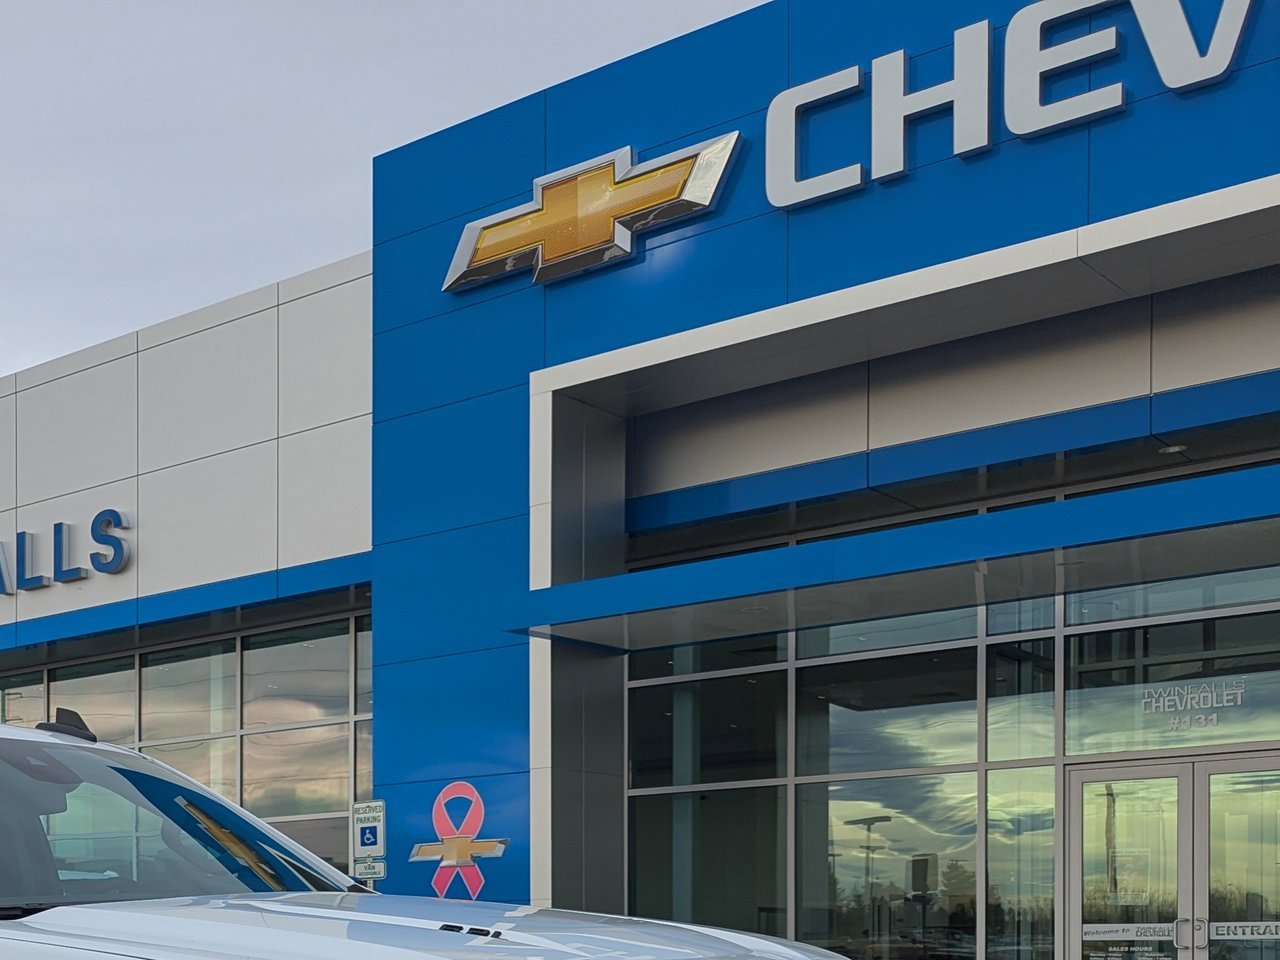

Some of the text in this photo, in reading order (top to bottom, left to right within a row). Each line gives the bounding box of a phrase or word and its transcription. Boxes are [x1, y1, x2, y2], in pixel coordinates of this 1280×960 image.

[765, 0, 1253, 210] CHEV
[1141, 689, 1246, 713] CHEVROLET
[1168, 713, 1219, 731] #131
[354, 805, 383, 815] RESERVED
[355, 815, 382, 825] PARKING
